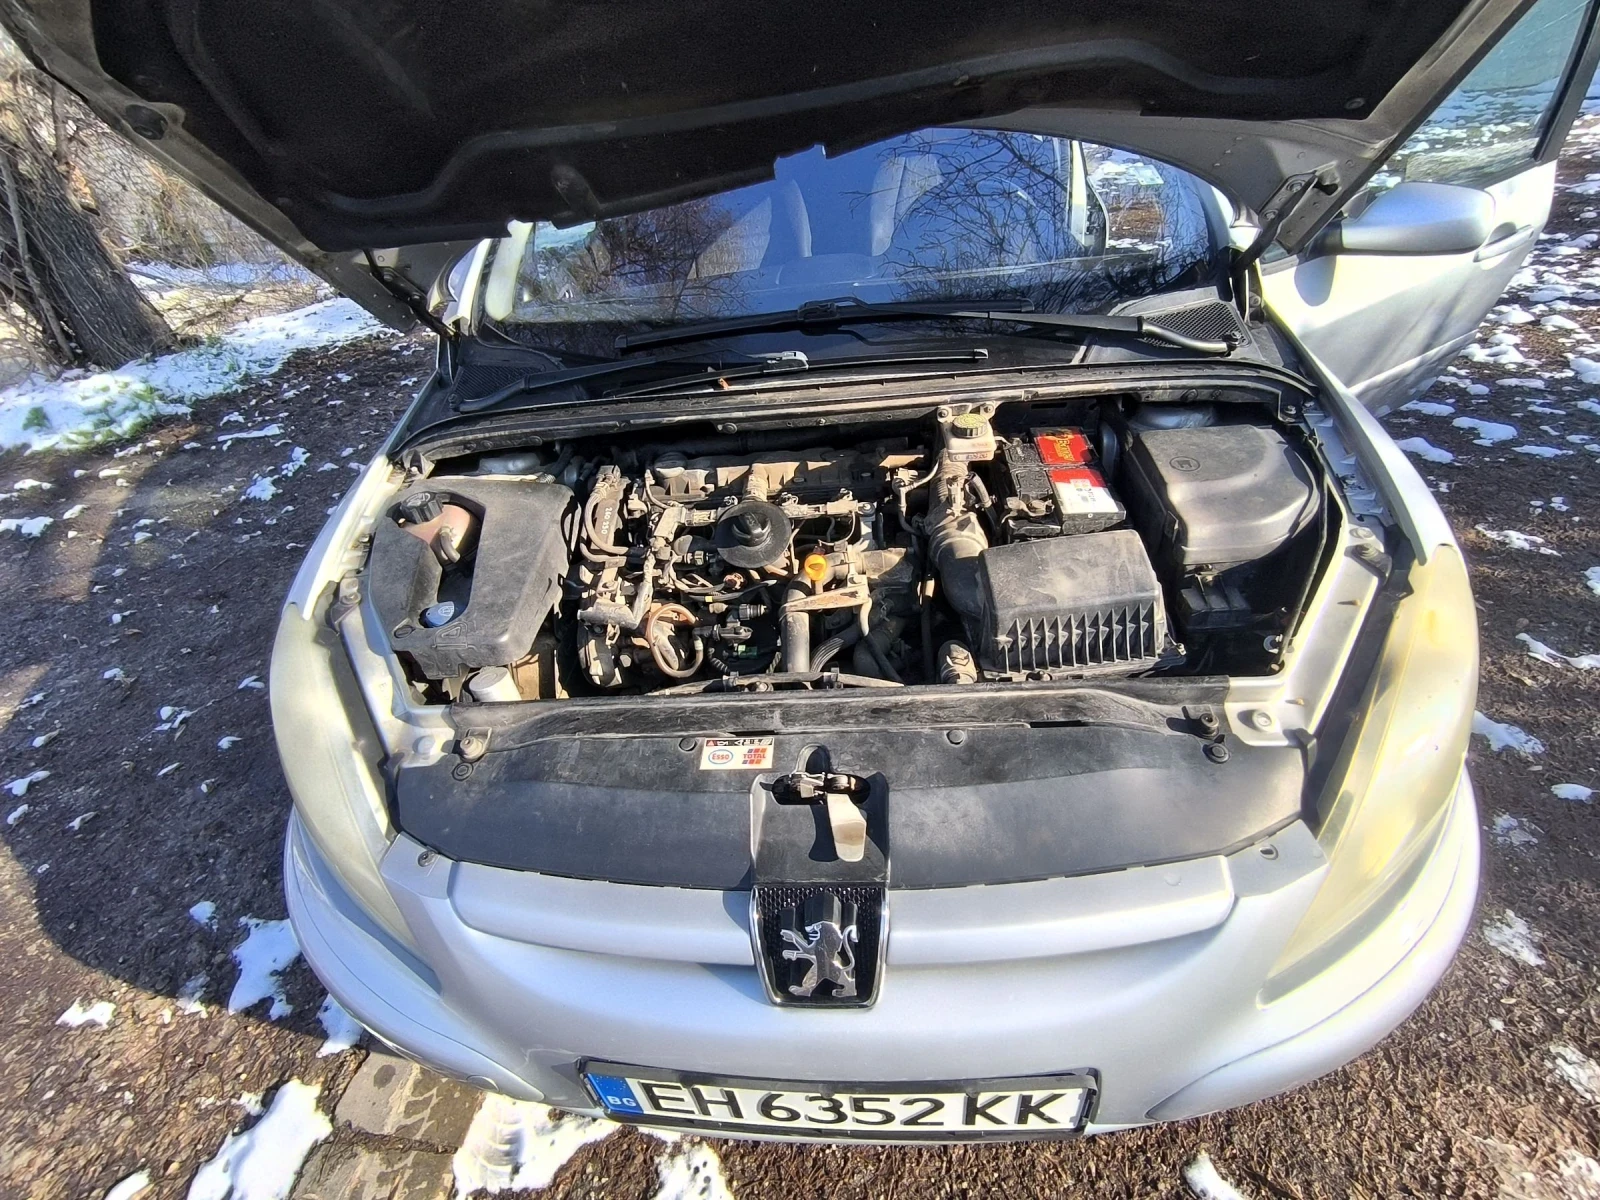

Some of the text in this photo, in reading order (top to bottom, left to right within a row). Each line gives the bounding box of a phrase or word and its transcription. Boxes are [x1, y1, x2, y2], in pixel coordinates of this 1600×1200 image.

[606, 1095, 637, 1107] BG
[637, 1080, 1067, 1126] EH 6352 KK
